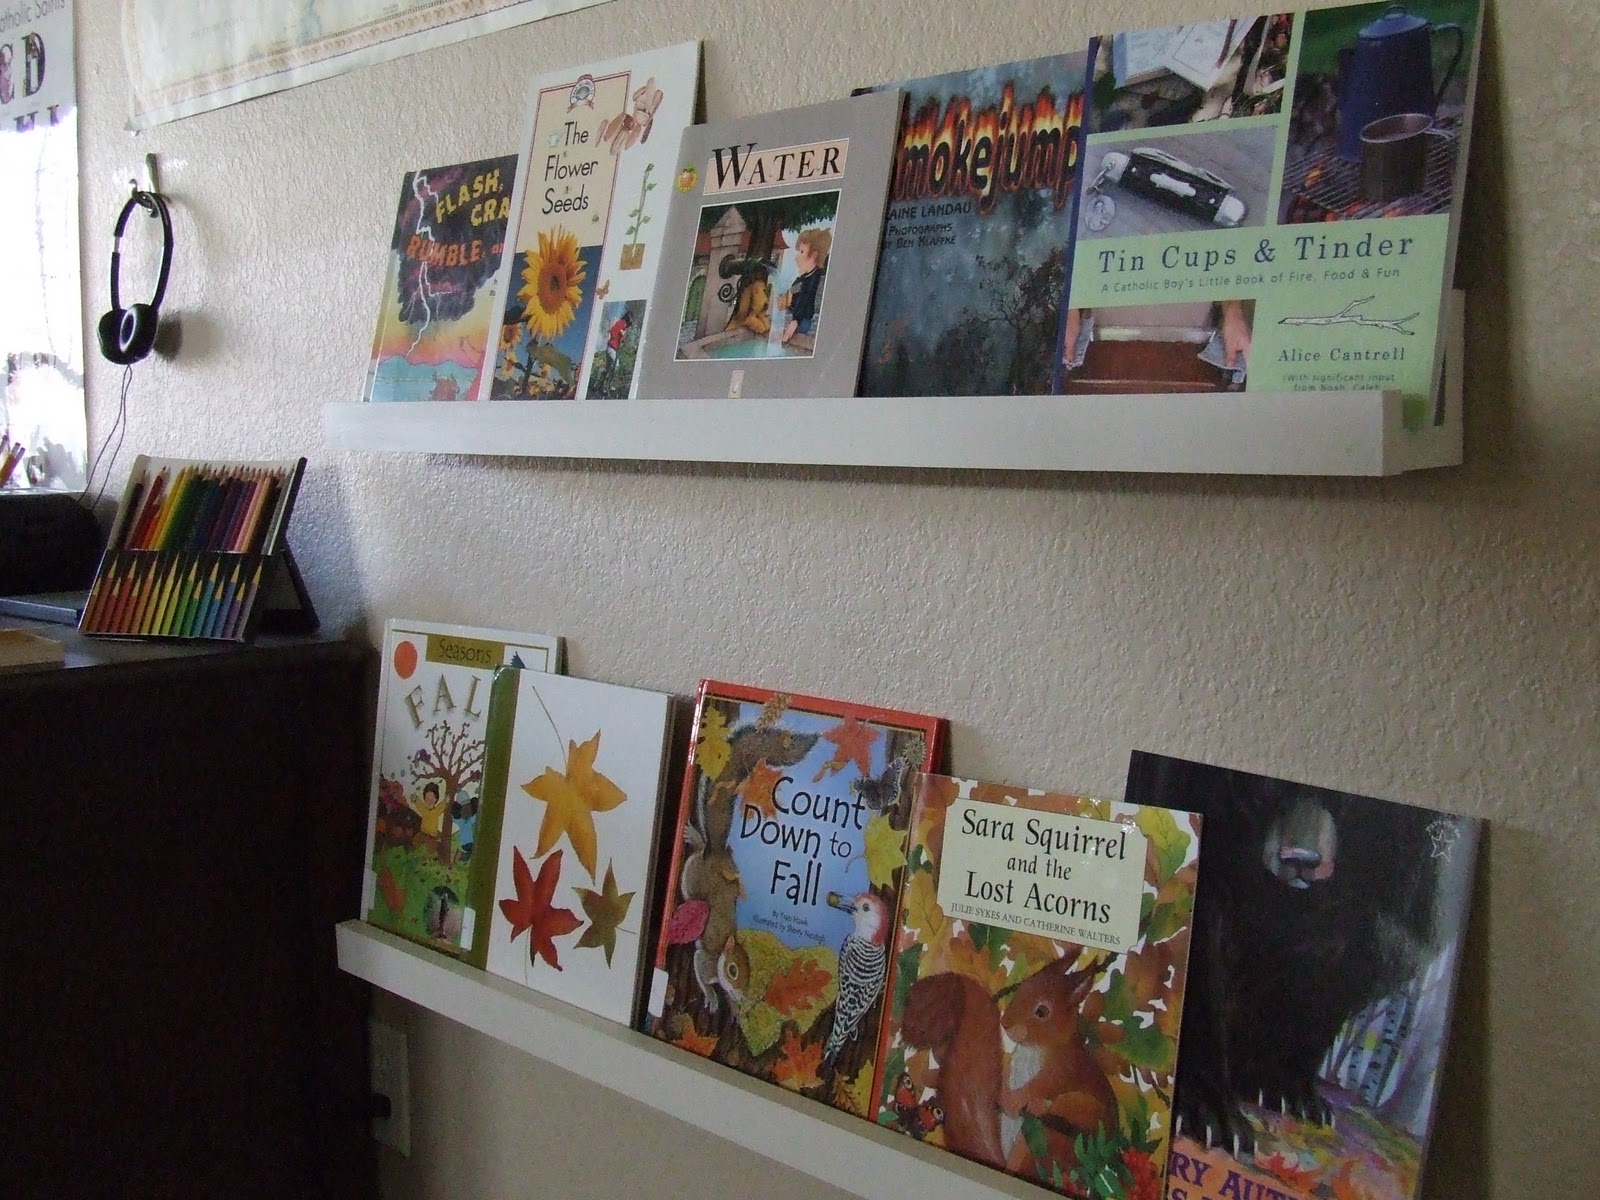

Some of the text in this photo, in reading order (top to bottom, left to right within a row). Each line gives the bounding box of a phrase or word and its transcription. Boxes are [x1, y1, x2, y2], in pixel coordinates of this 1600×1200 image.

[564, 121, 590, 146] The
[544, 154, 599, 182] Flower
[712, 142, 841, 190] WATER
[435, 168, 504, 224] FLASH,
[541, 183, 590, 215] Seeds
[920, 201, 972, 218] LANDAU
[1099, 233, 1415, 273] Tin Cups & Tinder
[1101, 281, 1110, 294] A
[1113, 278, 1159, 293] Catholic
[1163, 276, 1194, 292] Boy's
[1199, 274, 1231, 288] Little
[1235, 272, 1265, 286] Book
[1270, 271, 1284, 284] of
[1323, 267, 1356, 281] Food
[1361, 267, 1370, 280] &
[1376, 266, 1401, 279] Fun
[1278, 346, 1406, 362] Alice Cantrell
[438, 638, 493, 664] Seasons
[405, 673, 483, 729] FAL
[771, 775, 866, 830] Count
[740, 803, 852, 859] Down to
[961, 807, 1127, 860] Sara Squirrel
[770, 859, 823, 906] Fall
[1006, 855, 1072, 881] and the
[964, 870, 1111, 924] Lost Acorns
[950, 902, 1121, 946] JULIE SYKES AND CATHERINE WALTERS
